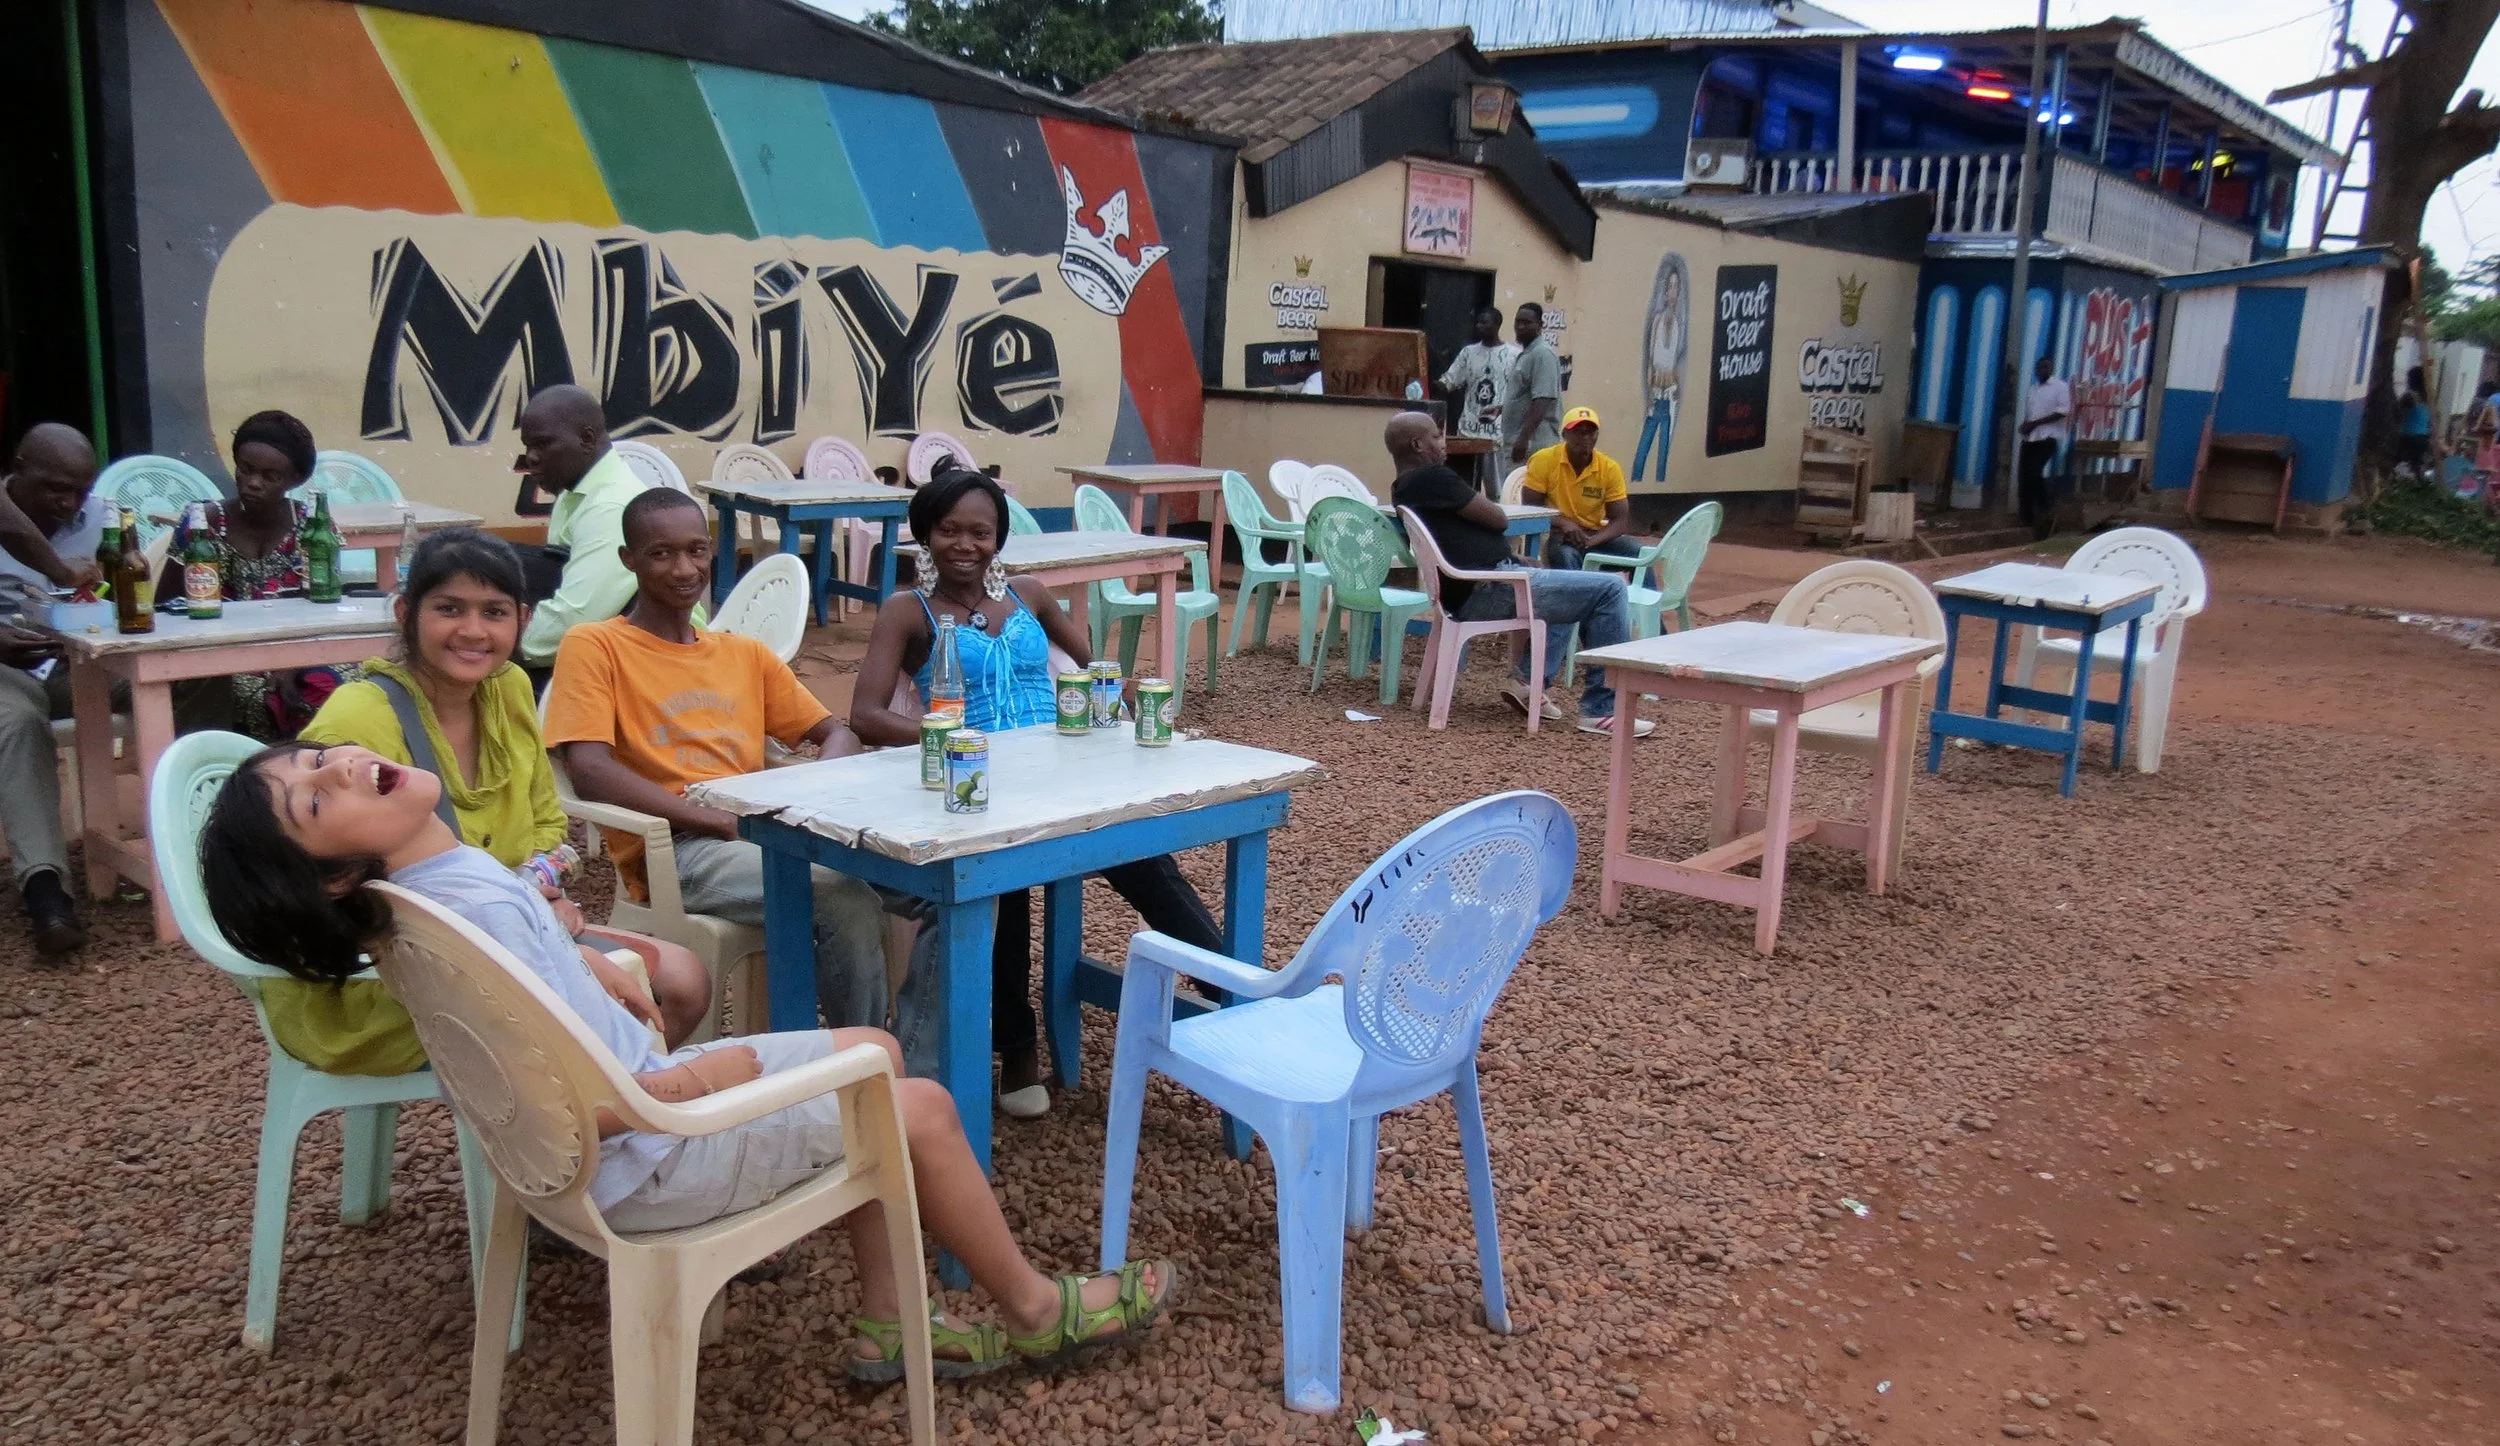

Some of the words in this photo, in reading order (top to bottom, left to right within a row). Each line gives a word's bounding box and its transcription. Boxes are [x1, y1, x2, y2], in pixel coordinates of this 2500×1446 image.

[1720, 280, 1770, 321] Draft
[361, 236, 1065, 446] MbiYé
[1726, 319, 1765, 351] Beer
[1262, 348, 1287, 366] Draft
[1290, 349, 1308, 363] Beer
[1719, 350, 1765, 382] House
